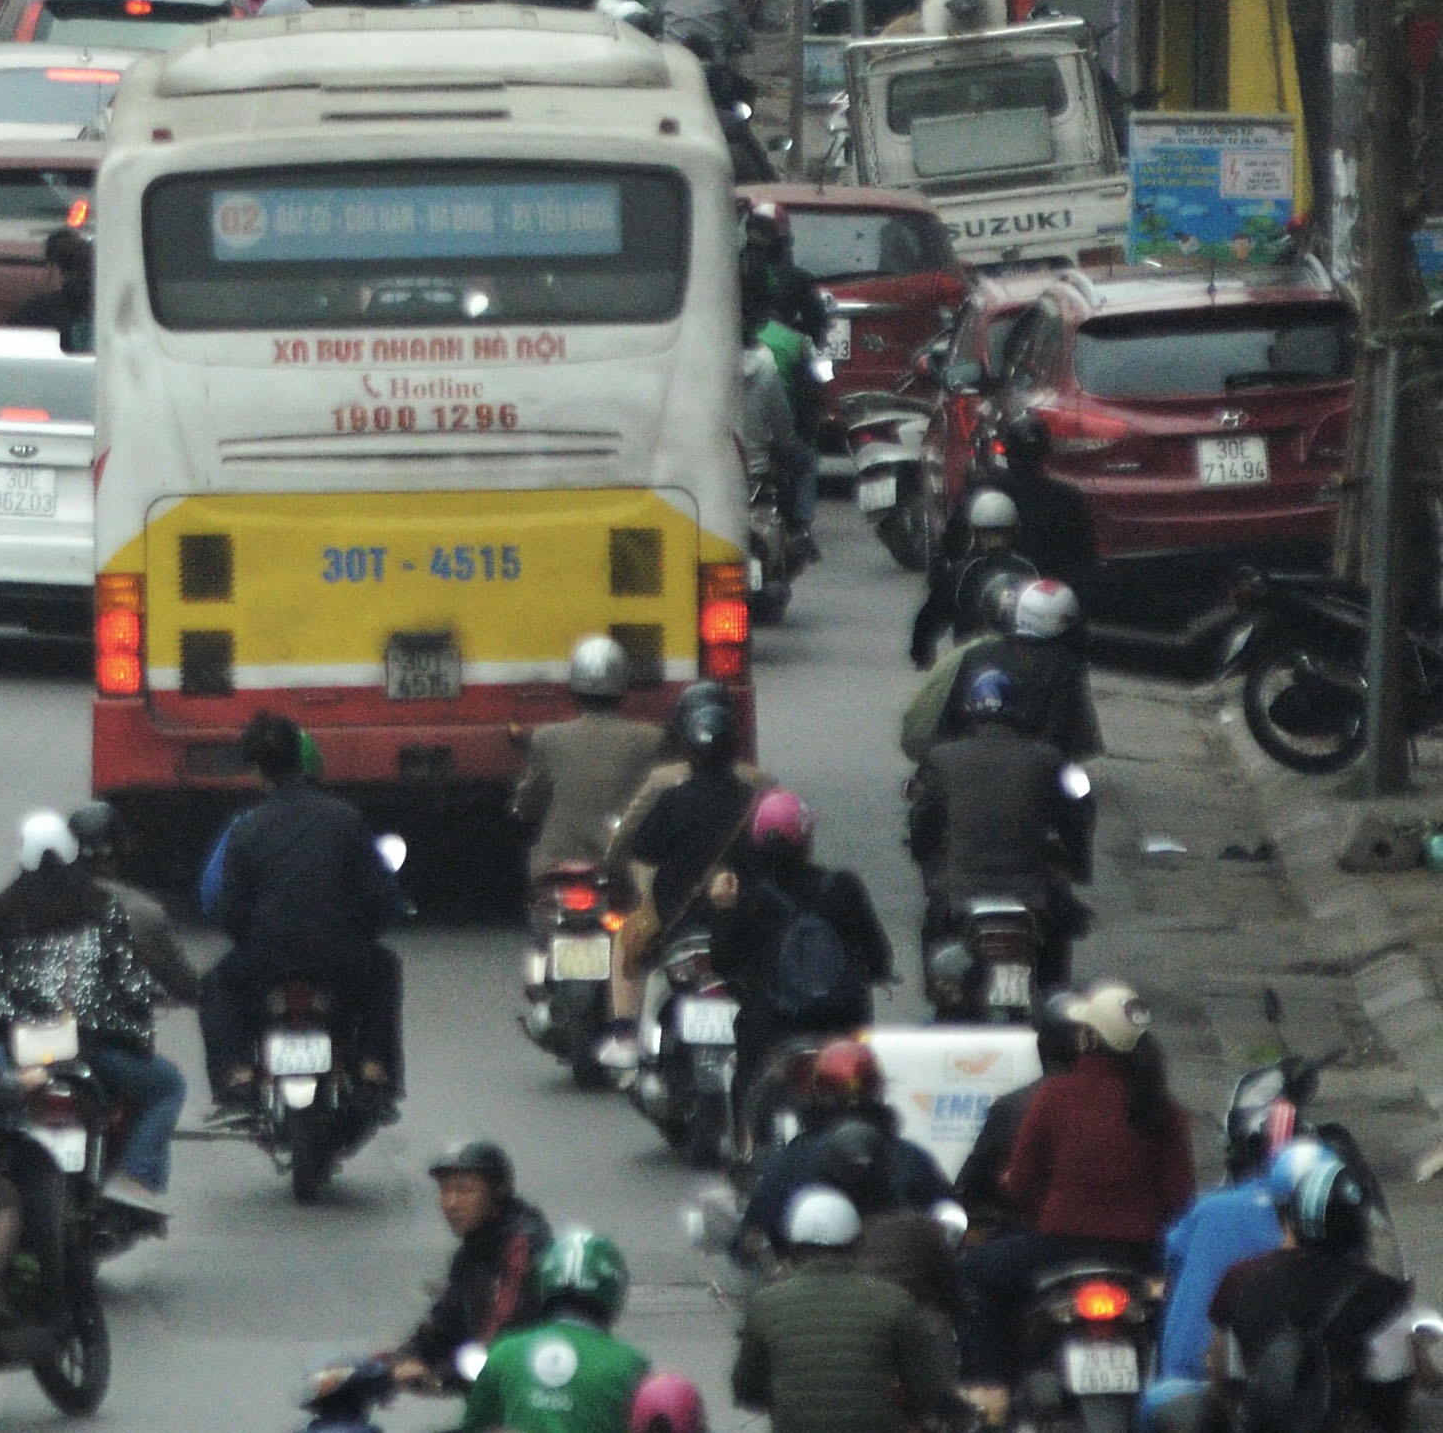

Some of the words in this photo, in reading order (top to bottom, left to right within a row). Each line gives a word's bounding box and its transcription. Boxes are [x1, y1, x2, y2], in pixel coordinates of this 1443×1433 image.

[220, 204, 262, 235] 02
[947, 209, 1072, 240] SUZUKI
[316, 338, 364, 363] BUS
[473, 330, 510, 360] HÀ
[390, 377, 484, 399] Hotline
[331, 404, 416, 432] 1900
[432, 403, 519, 432] 1296
[322, 545, 388, 583] 30T
[430, 544, 523, 582] 4515
